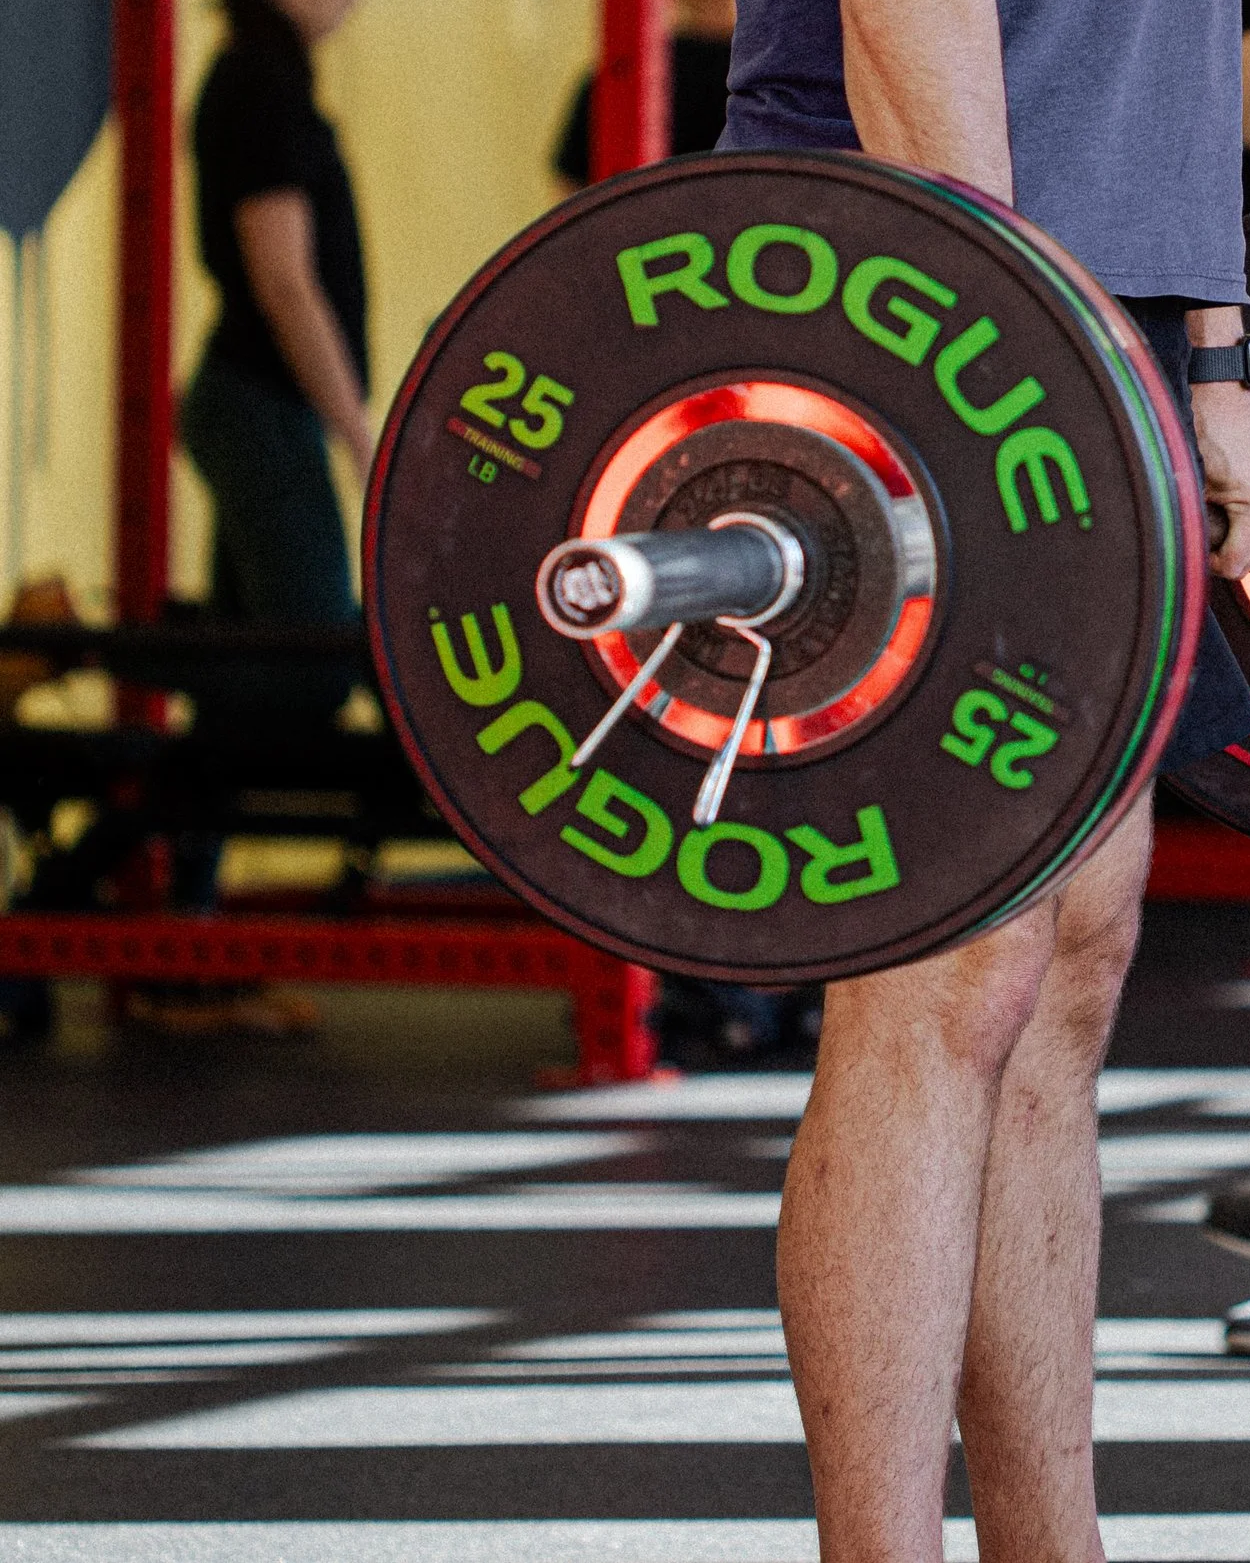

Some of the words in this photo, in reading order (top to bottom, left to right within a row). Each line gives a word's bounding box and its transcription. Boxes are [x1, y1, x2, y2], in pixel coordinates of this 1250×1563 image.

[460, 350, 575, 449] 25
[616, 223, 1092, 534] ROGUE
[467, 454, 498, 484] LB
[431, 602, 901, 912] ROGUE
[940, 688, 1060, 790] 25
